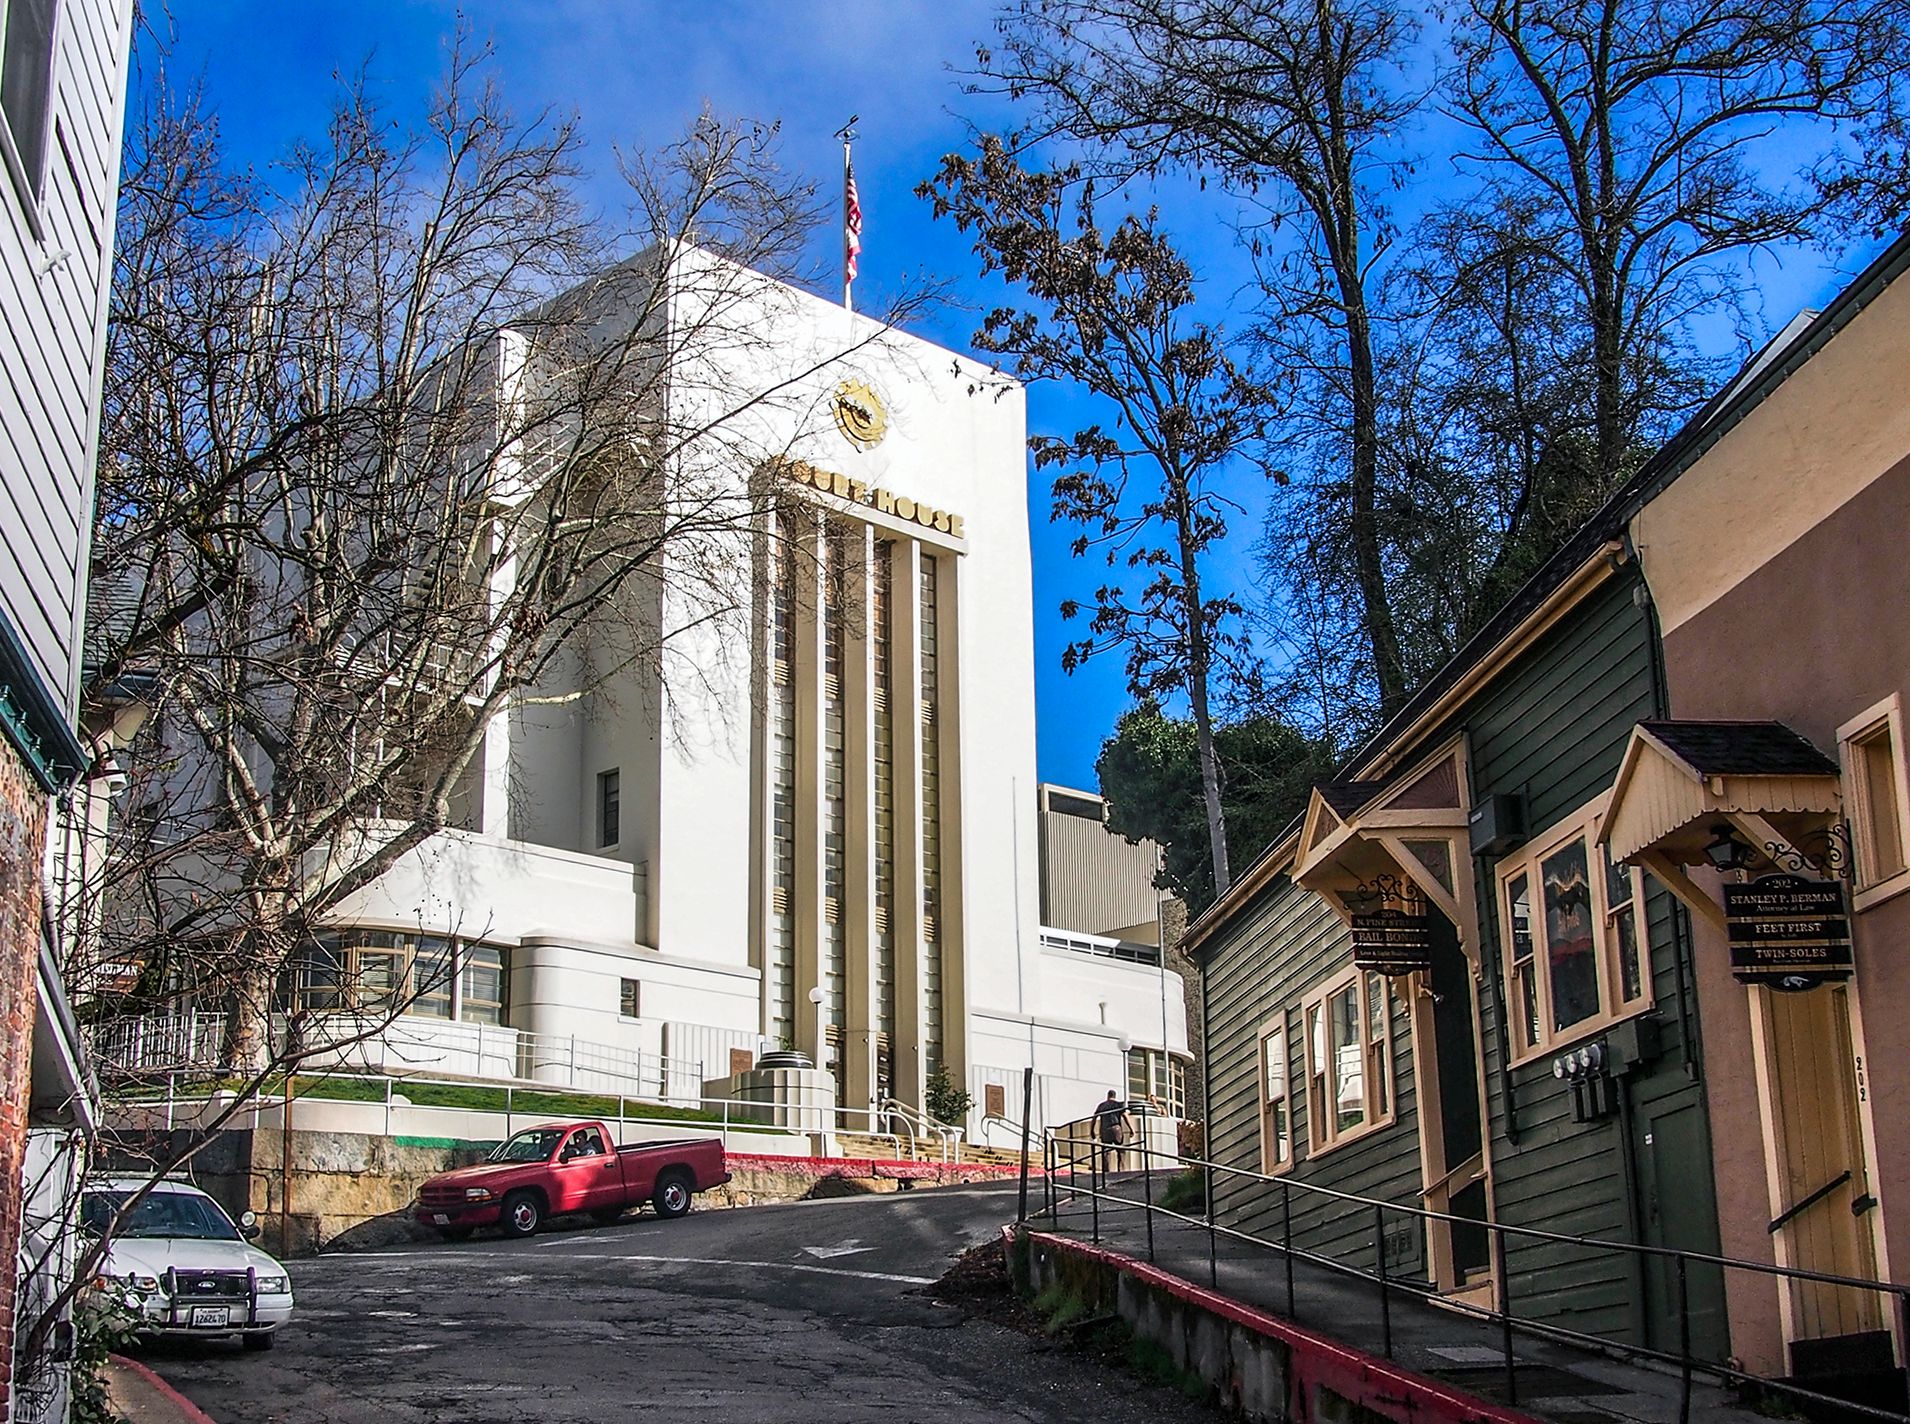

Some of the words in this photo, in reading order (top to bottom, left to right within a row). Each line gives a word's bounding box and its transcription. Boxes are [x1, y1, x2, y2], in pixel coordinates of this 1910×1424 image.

[873, 487, 965, 540] HOUSE
[1730, 894, 1777, 904] STANLEY
[1780, 894, 1790, 903] P.
[1791, 893, 1836, 903] BERMAN
[1755, 923, 1785, 933] FEET
[1788, 922, 1822, 932] FIRST
[1358, 932, 1383, 942] BAIL
[1755, 948, 1827, 958] TWIN-SOLES
[1856, 1056, 1866, 1102] 202
